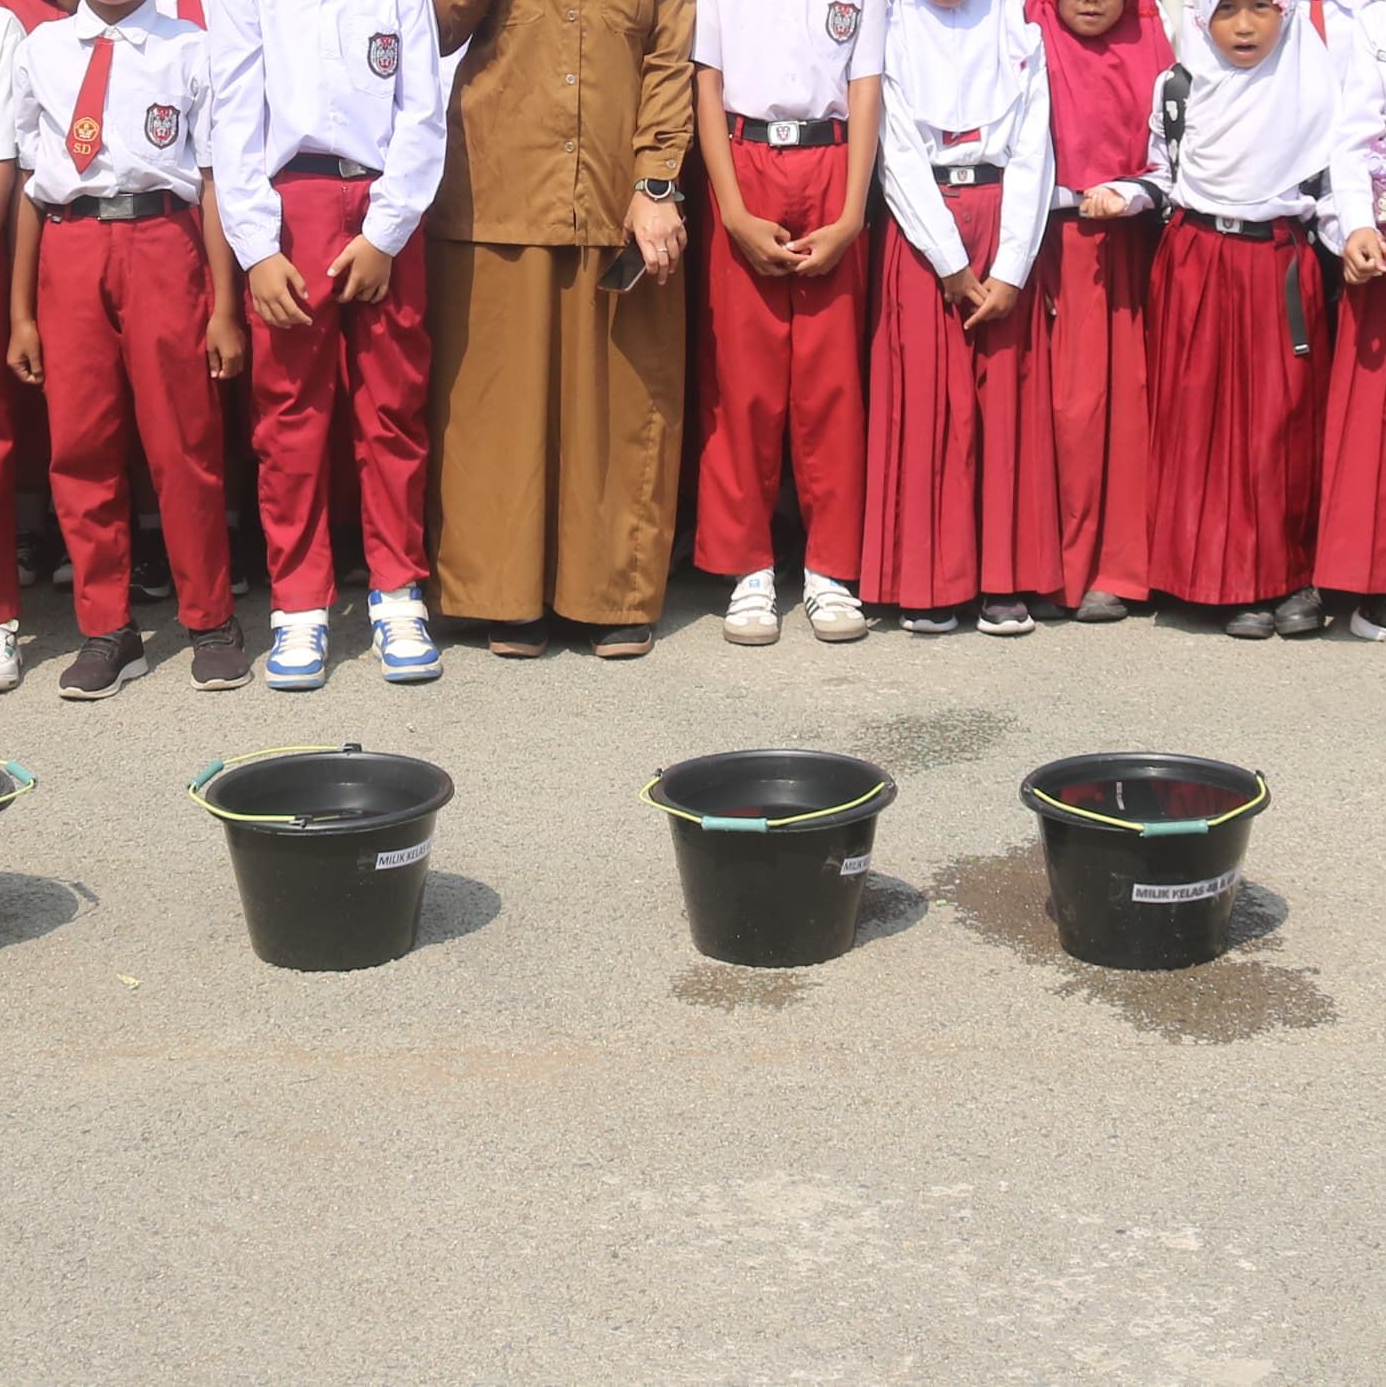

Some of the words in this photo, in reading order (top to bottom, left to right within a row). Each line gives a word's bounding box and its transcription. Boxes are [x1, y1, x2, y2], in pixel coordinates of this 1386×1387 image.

[72, 142, 92, 155] SD
[378, 853, 405, 866] MILIK
[1135, 888, 1170, 899] MILIK
[1172, 886, 1204, 899] KELAS
